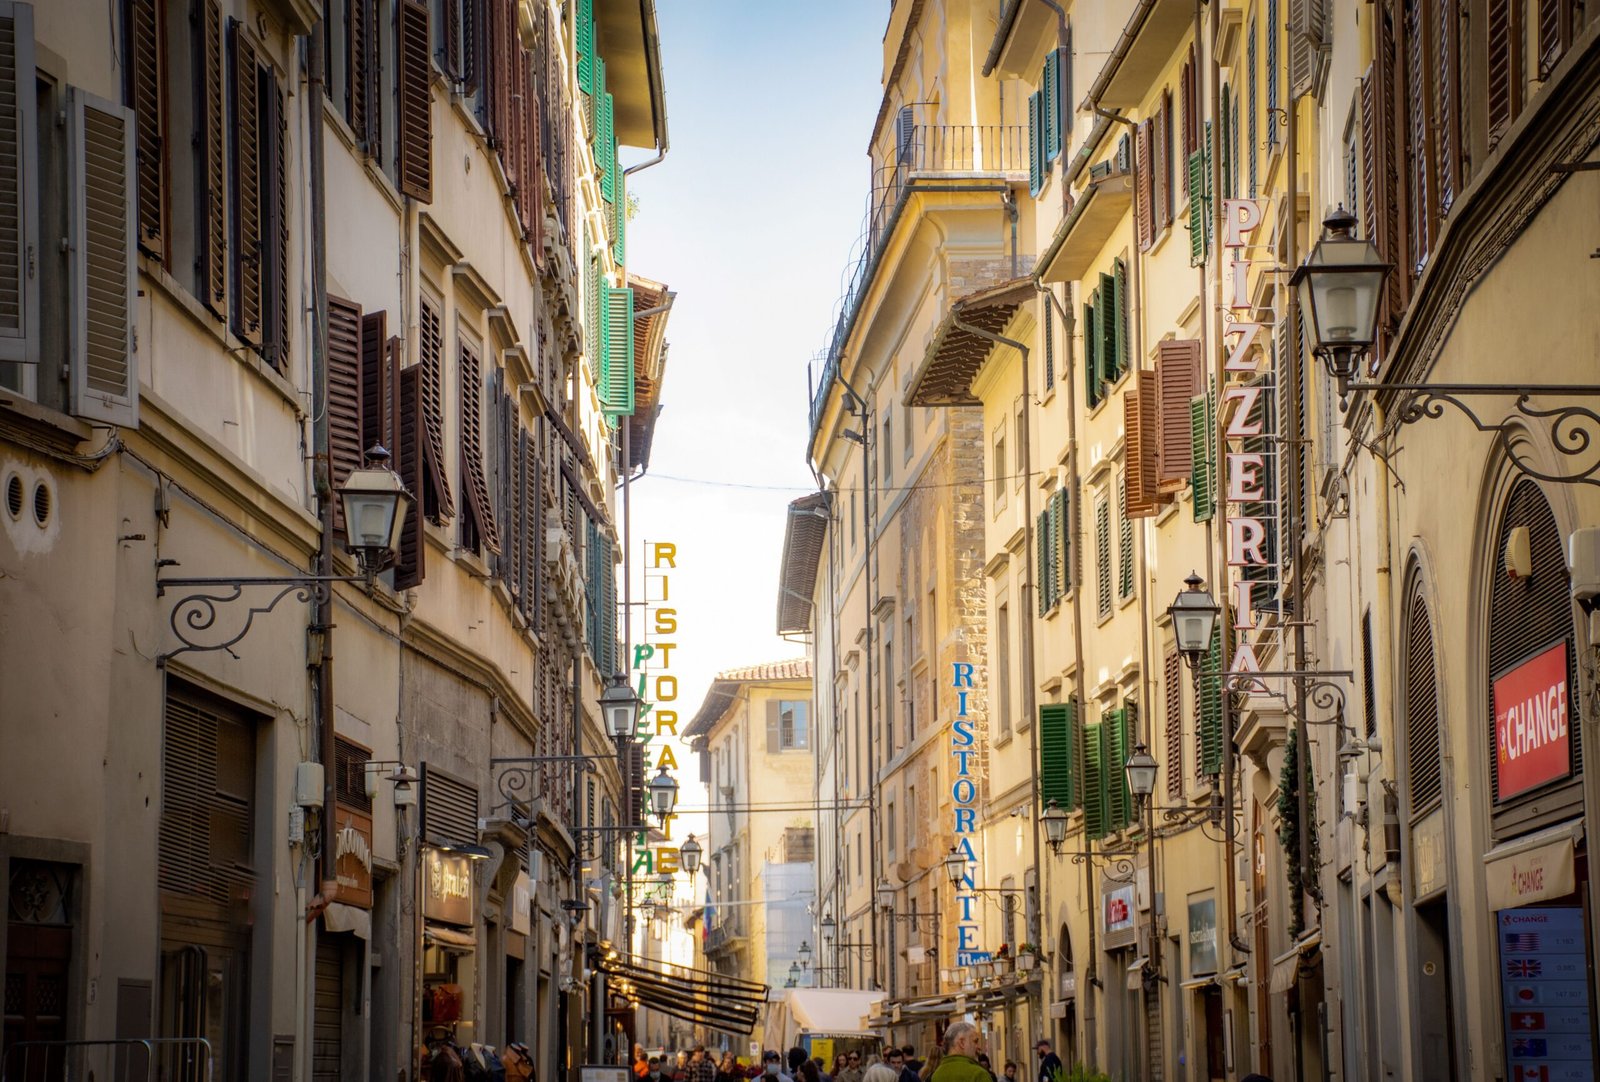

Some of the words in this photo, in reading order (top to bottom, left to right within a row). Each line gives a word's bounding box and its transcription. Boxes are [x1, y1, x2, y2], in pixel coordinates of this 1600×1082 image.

[1223, 199, 1267, 692] PIZZERIA
[655, 543, 678, 874] RISTORATE
[1507, 681, 1567, 760] CHANGE
[1518, 868, 1544, 895] CHANGE
